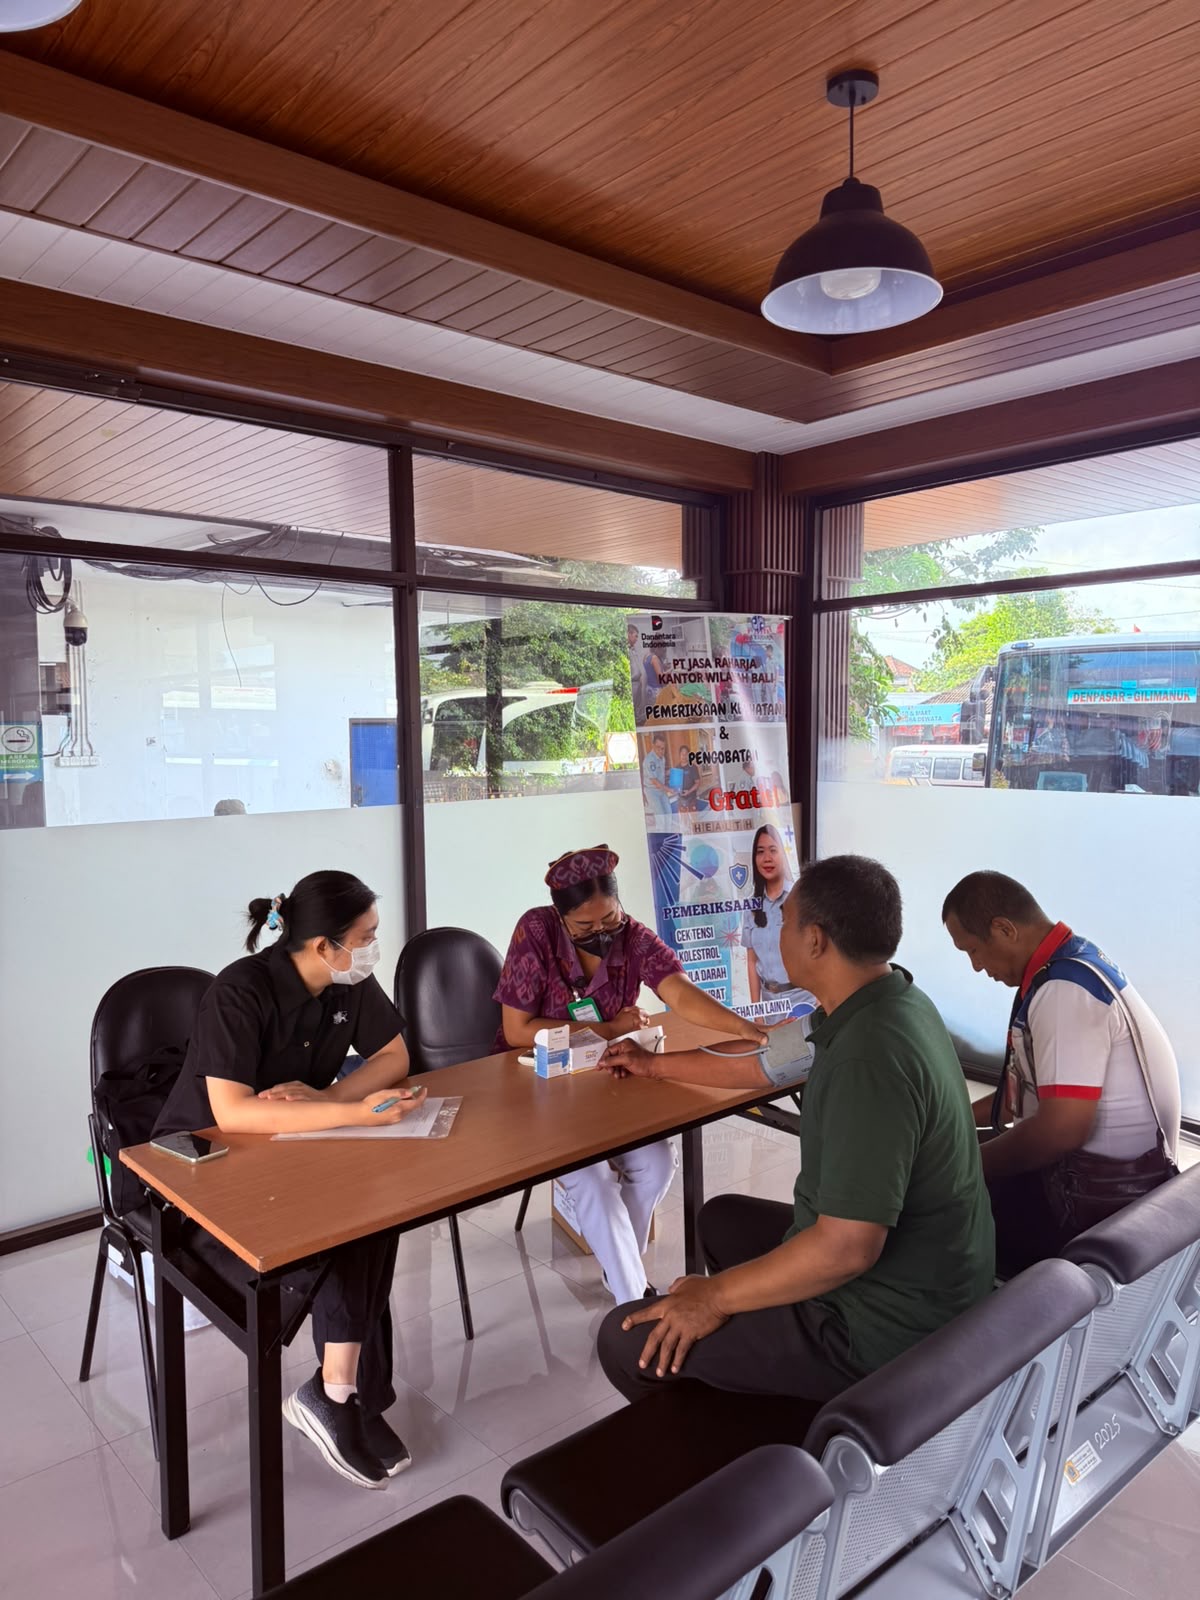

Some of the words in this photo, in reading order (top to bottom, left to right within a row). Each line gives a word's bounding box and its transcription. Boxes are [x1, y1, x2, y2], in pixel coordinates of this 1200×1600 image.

[641, 633, 676, 641] Danantara
[642, 640, 676, 648] Indonesia
[673, 658, 686, 669] PT
[688, 658, 712, 671] JASA
[714, 657, 757, 671] RAHARJA
[658, 672, 704, 684] KANTOR
[705, 671, 748, 683] WILAAH
[751, 672, 774, 683] BALI
[1073, 691, 1125, 703] DENPASAR
[1133, 690, 1191, 702] GILIMANUK
[645, 701, 727, 719] PEMERIKSAAN
[719, 726, 729, 740] &
[694, 820, 752, 832] HEALTH
[663, 898, 761, 919] PEMERIKSAAN
[676, 929, 691, 942] CEK
[692, 926, 714, 940] TENSI
[679, 947, 720, 962] KOLESTROL
[700, 967, 727, 981] DARAH
[765, 1000, 792, 1014] LAINYA
[1094, 1413, 1121, 1449] 2025
